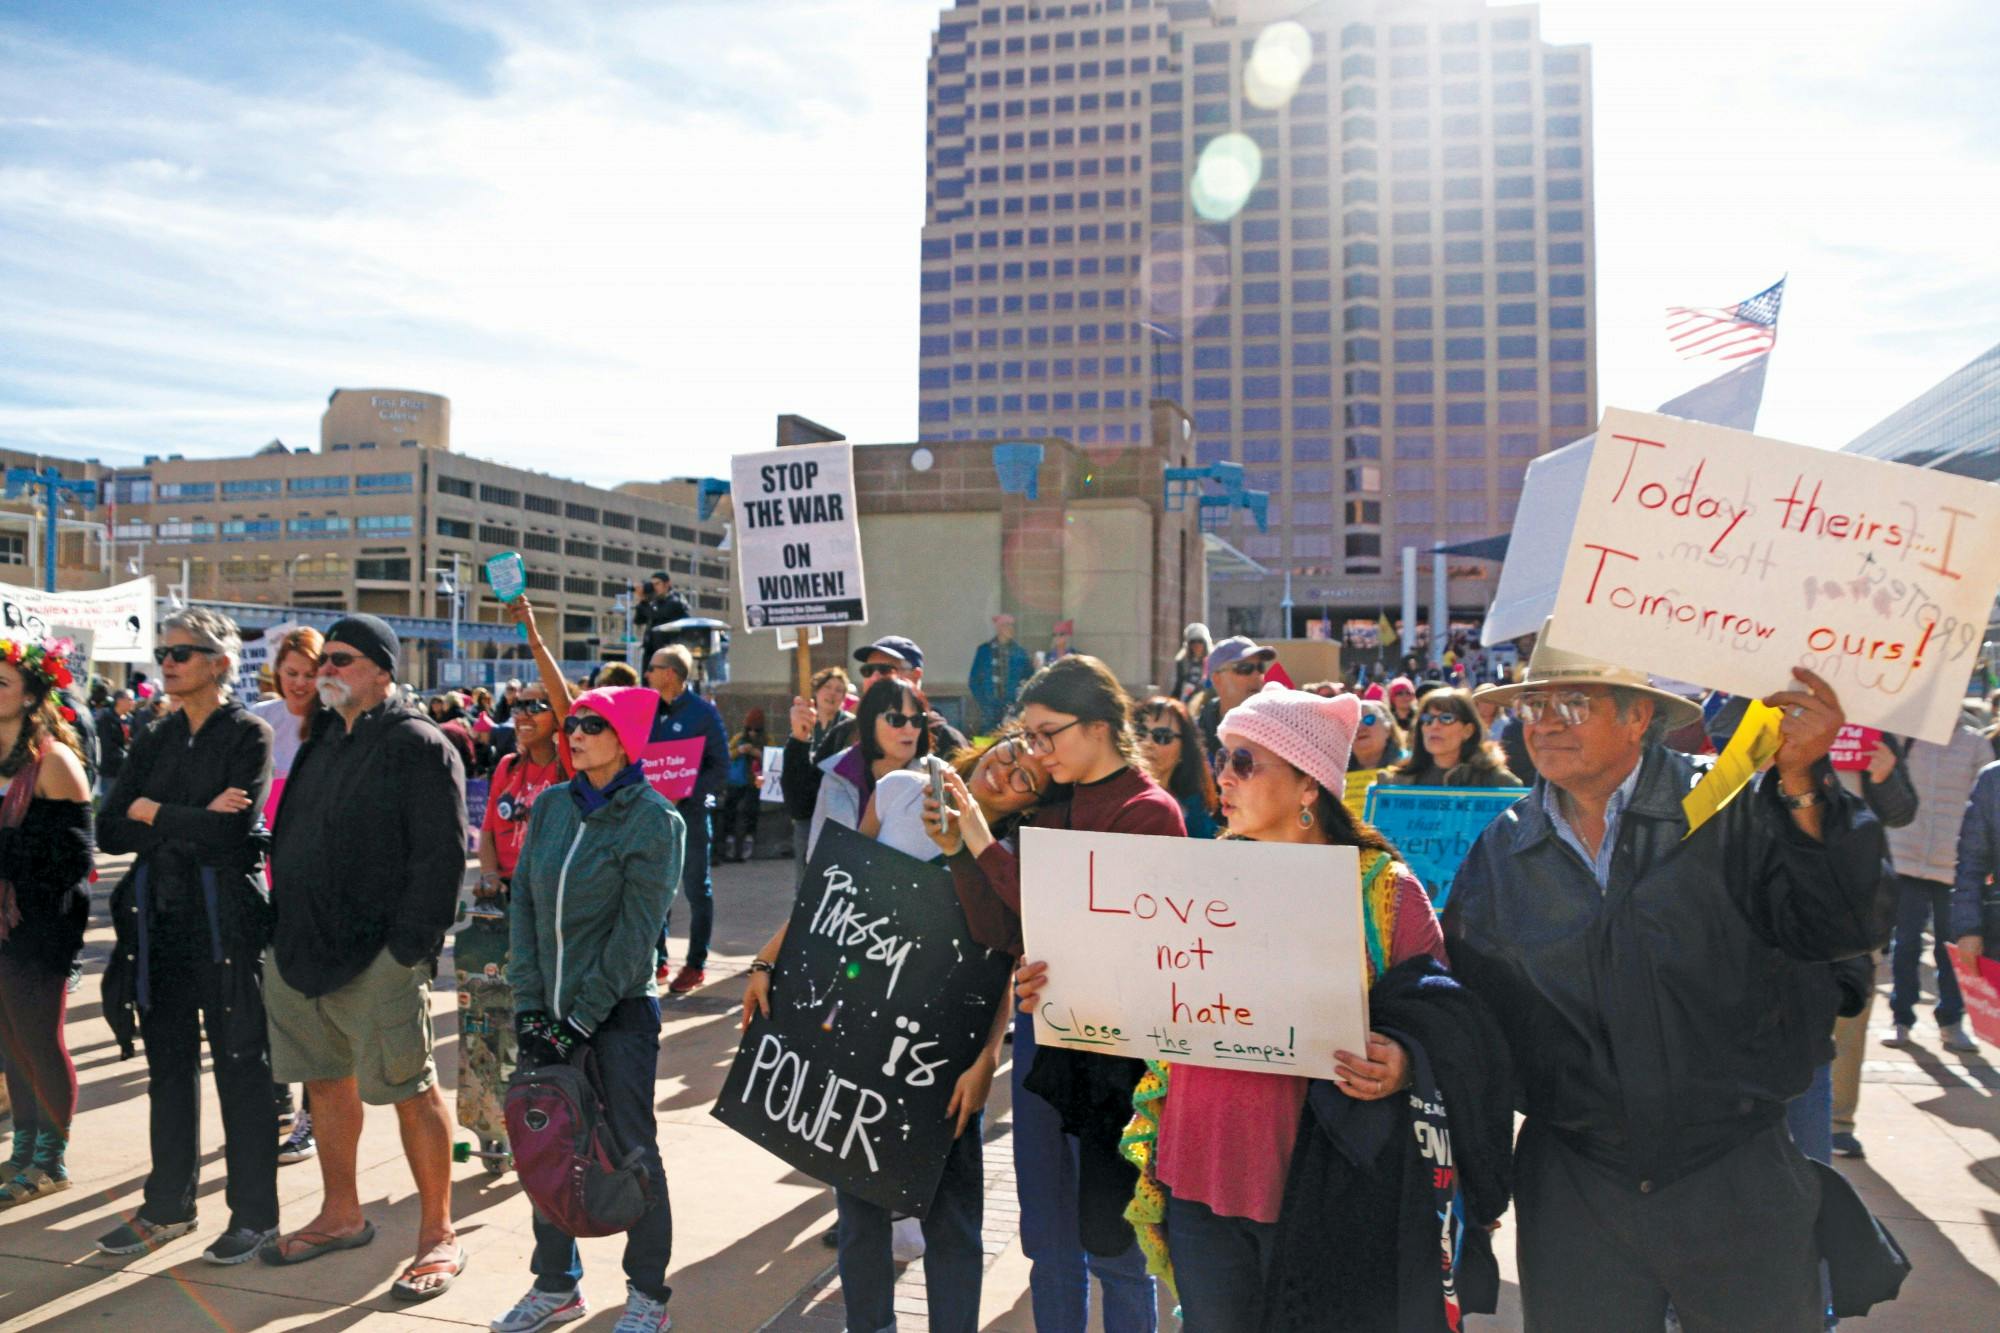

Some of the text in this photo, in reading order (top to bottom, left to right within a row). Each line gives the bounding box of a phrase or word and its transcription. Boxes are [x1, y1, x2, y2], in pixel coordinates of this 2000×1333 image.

[761, 461, 818, 494] STOP
[1612, 434, 1747, 553] Today
[744, 493, 844, 528] THE WAR
[782, 542, 811, 569] ON
[758, 571, 845, 600] WOMEN!
[1584, 543, 1936, 668] Tomorrow ours!
[1392, 799, 1414, 810] THIS
[1418, 799, 1450, 811] HOUSE
[1407, 819, 1441, 831] that
[1089, 850, 1237, 927] Love
[1157, 937, 1213, 970] not
[1171, 982, 1255, 1026] hate
[1041, 1002, 1296, 1060] Close the camps!
[741, 1034, 887, 1172] POWER
